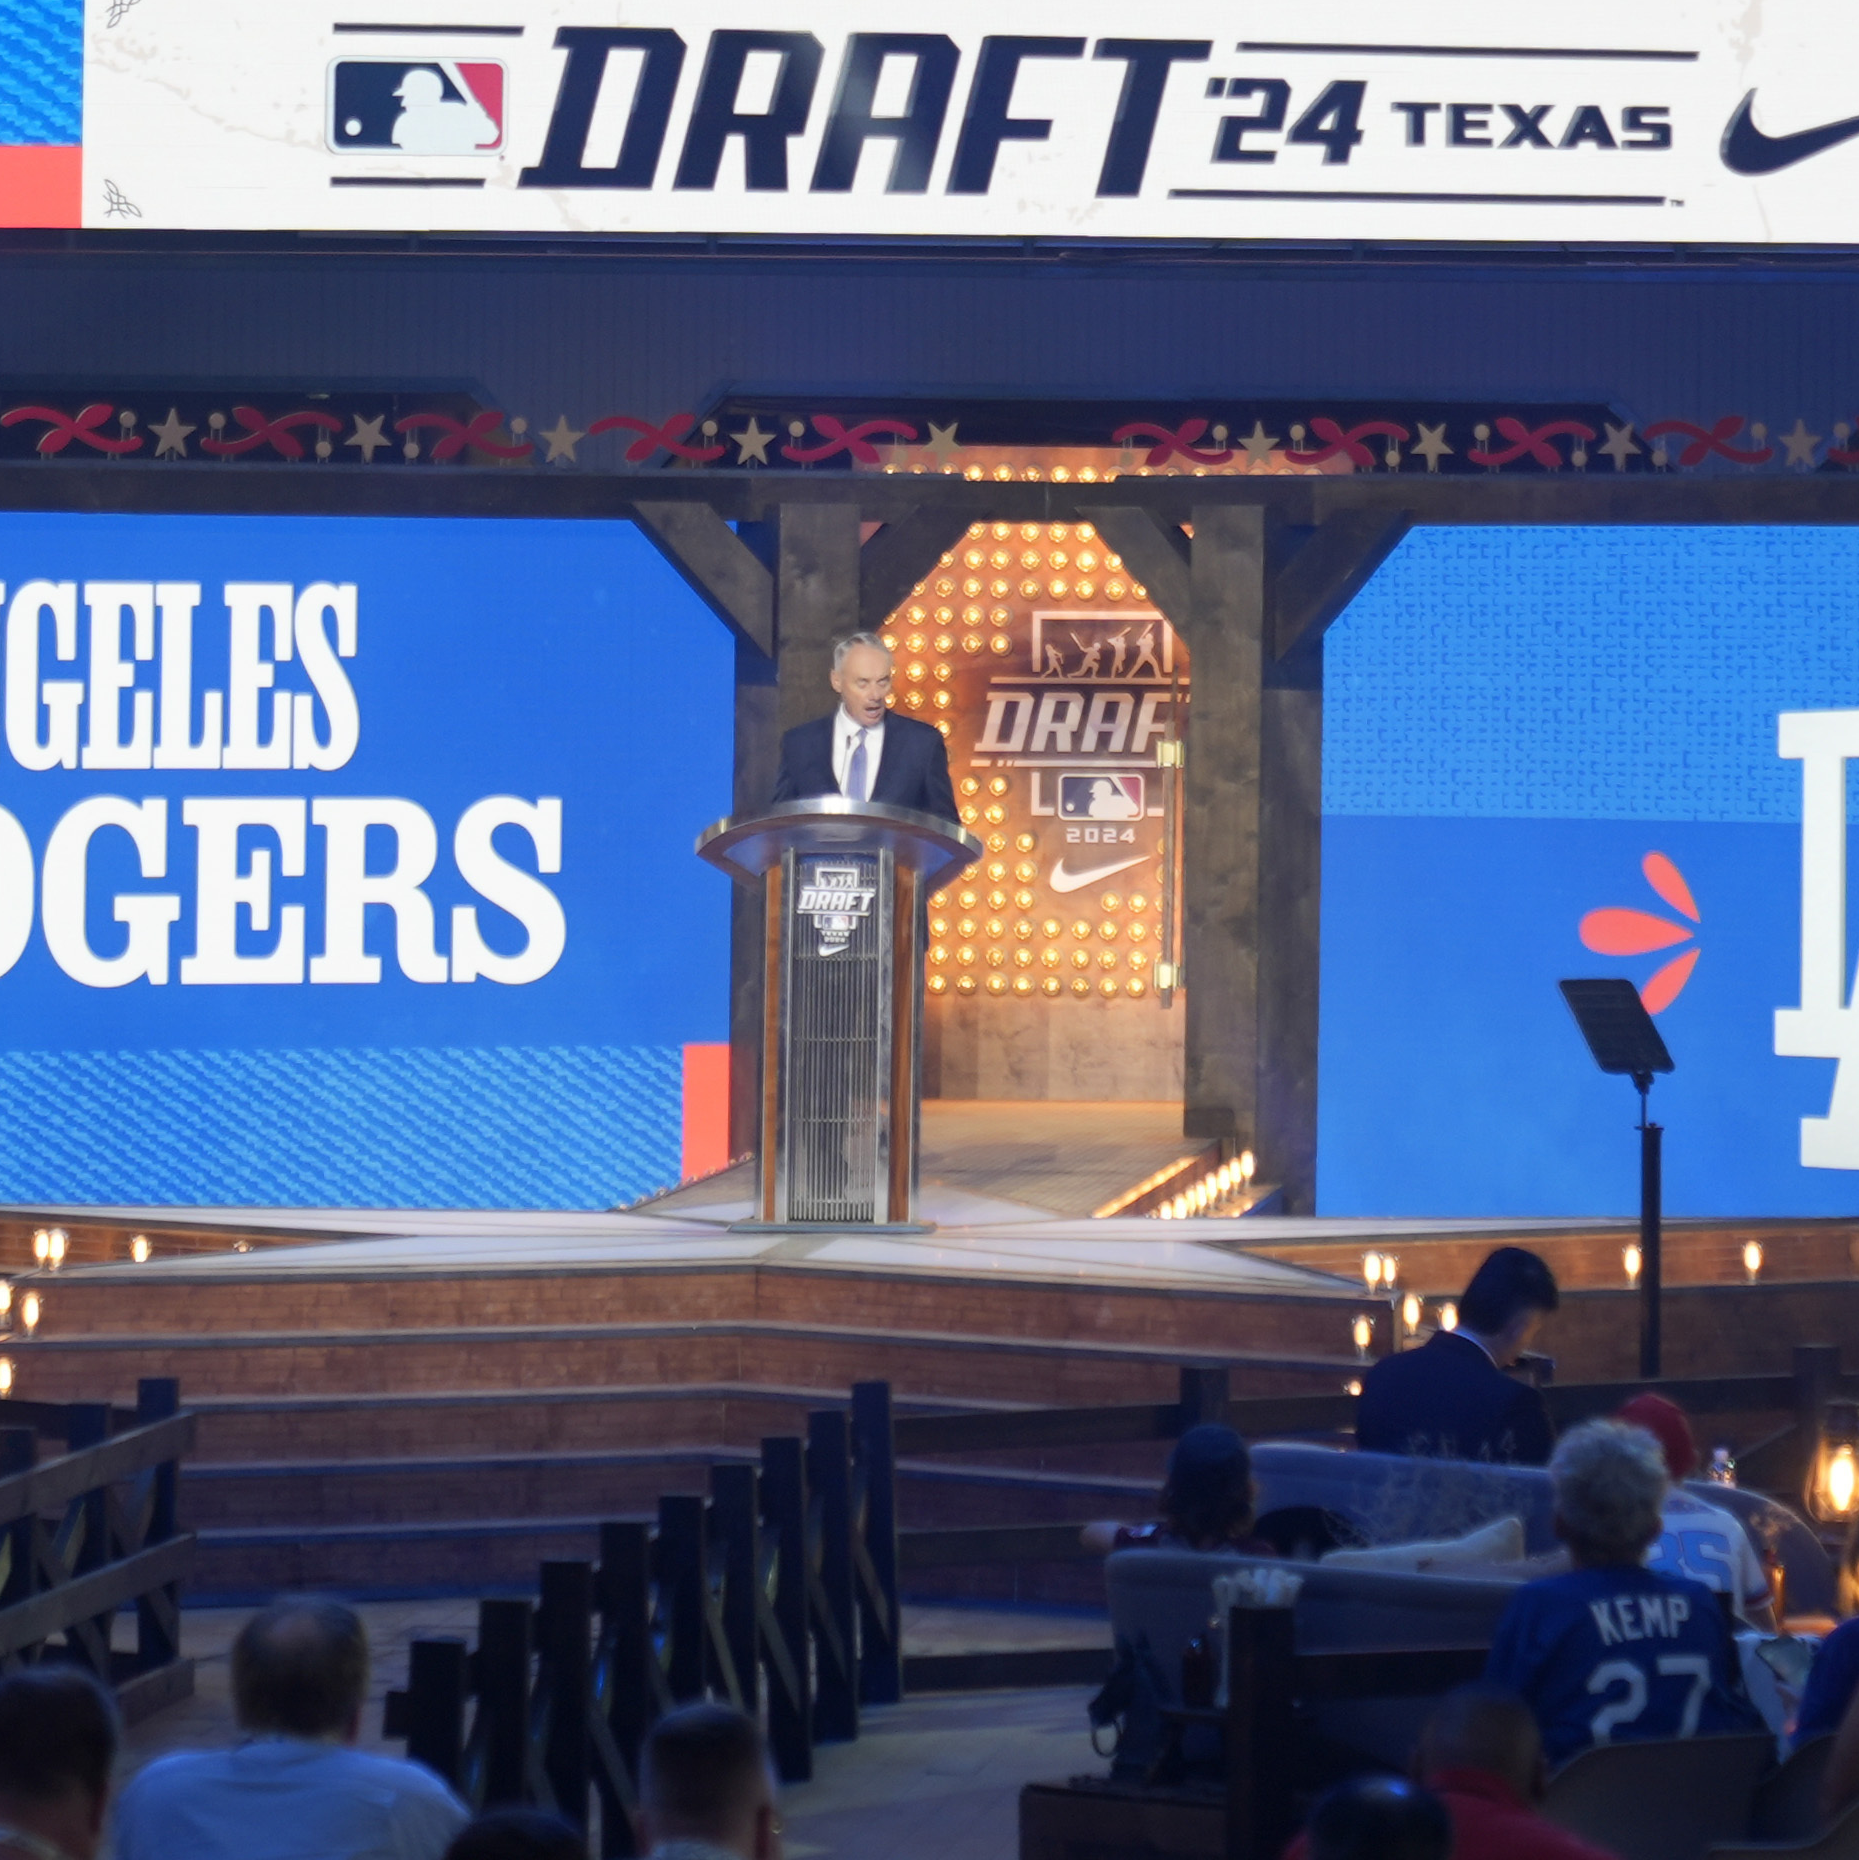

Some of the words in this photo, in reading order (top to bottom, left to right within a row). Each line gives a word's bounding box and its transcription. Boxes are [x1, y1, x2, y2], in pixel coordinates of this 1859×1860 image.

[517, 26, 1212, 198] DRAFT
[1205, 77, 1367, 164] '24
[1391, 101, 1673, 149] TEXAS
[974, 691, 1190, 752] DRAF
[1066, 828, 1135, 843] 2024
[798, 890, 875, 911] DRAFT
[1589, 1595, 1689, 1646] KEMP
[1587, 1654, 1712, 1744] 27
